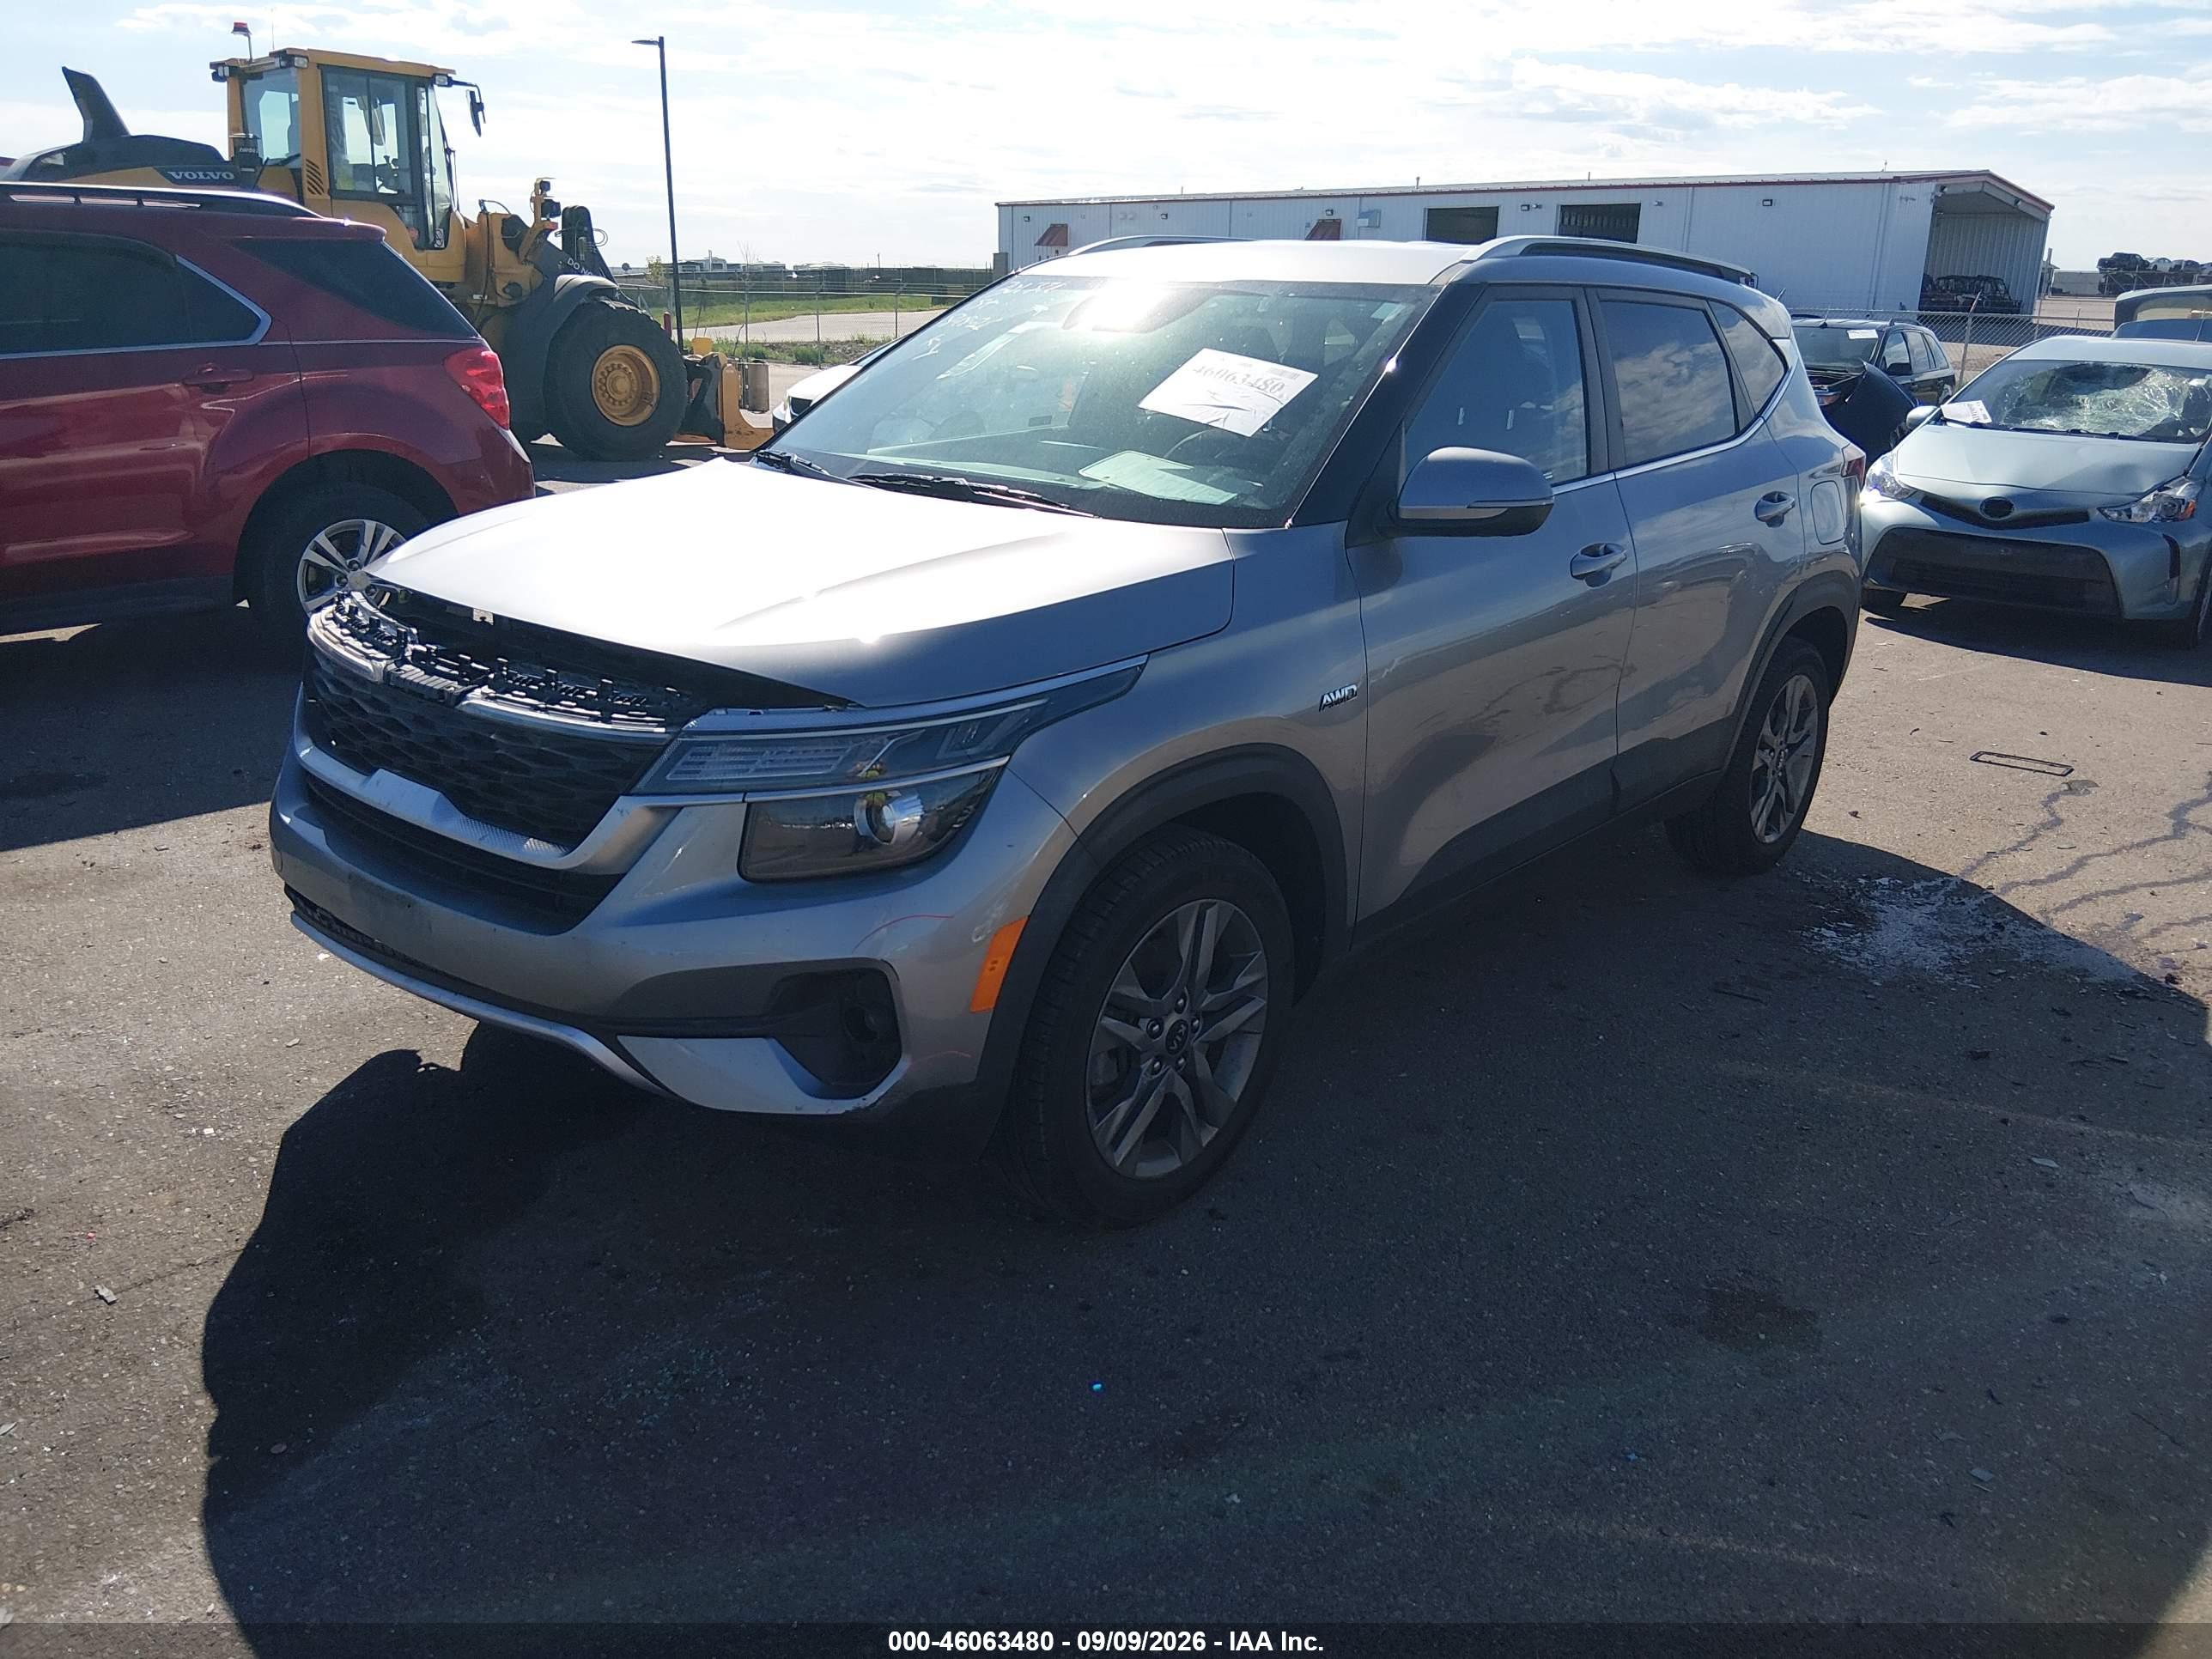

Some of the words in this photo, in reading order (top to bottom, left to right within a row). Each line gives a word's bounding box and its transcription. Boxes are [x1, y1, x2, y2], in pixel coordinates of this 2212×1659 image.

[167, 171, 234, 179] VOLVO
[568, 257, 580, 270] DO
[1319, 684, 1358, 711] AWD
